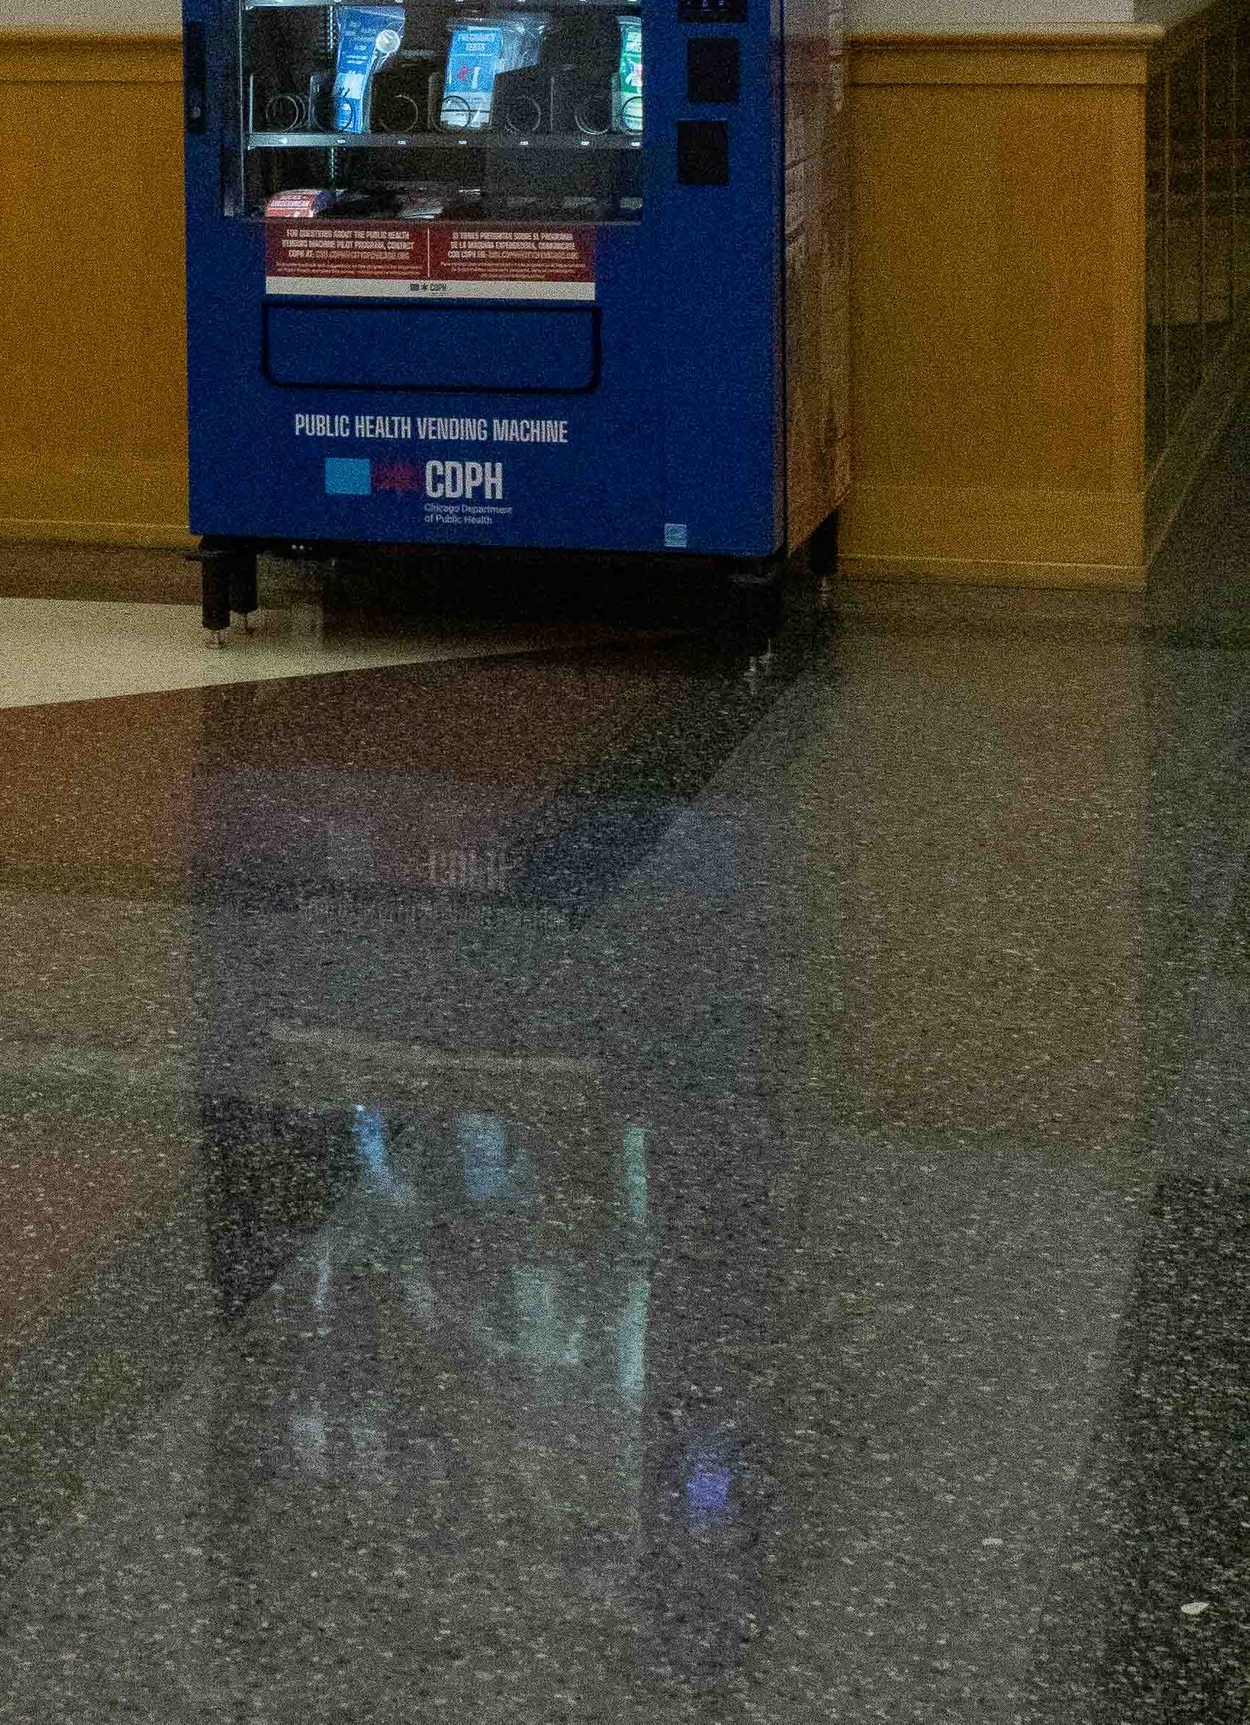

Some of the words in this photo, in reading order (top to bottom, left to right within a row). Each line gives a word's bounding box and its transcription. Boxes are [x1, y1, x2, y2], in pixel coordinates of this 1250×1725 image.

[286, 229, 298, 237] FOR
[300, 230, 332, 238] QUESTIONS
[334, 230, 352, 238] ABOUT
[354, 230, 365, 239] THE
[366, 231, 387, 239] PUBLIC
[388, 231, 409, 239] HEALTH
[282, 239, 307, 248] VENDING
[309, 240, 336, 248] MACHINE
[337, 240, 353, 249] PILOT
[387, 241, 415, 250] CONTACT
[289, 250, 304, 258] CDPH
[295, 414, 350, 437] PUBLIC
[355, 415, 411, 439] HEALTH
[417, 417, 488, 441] VENDING
[492, 419, 568, 443] MACHINE
[425, 460, 503, 500] CDPH
[424, 502, 461, 514] Chicago
[461, 504, 512, 516] Department
[424, 514, 434, 523] of
[436, 514, 463, 524] Public
[464, 515, 493, 525] Health
